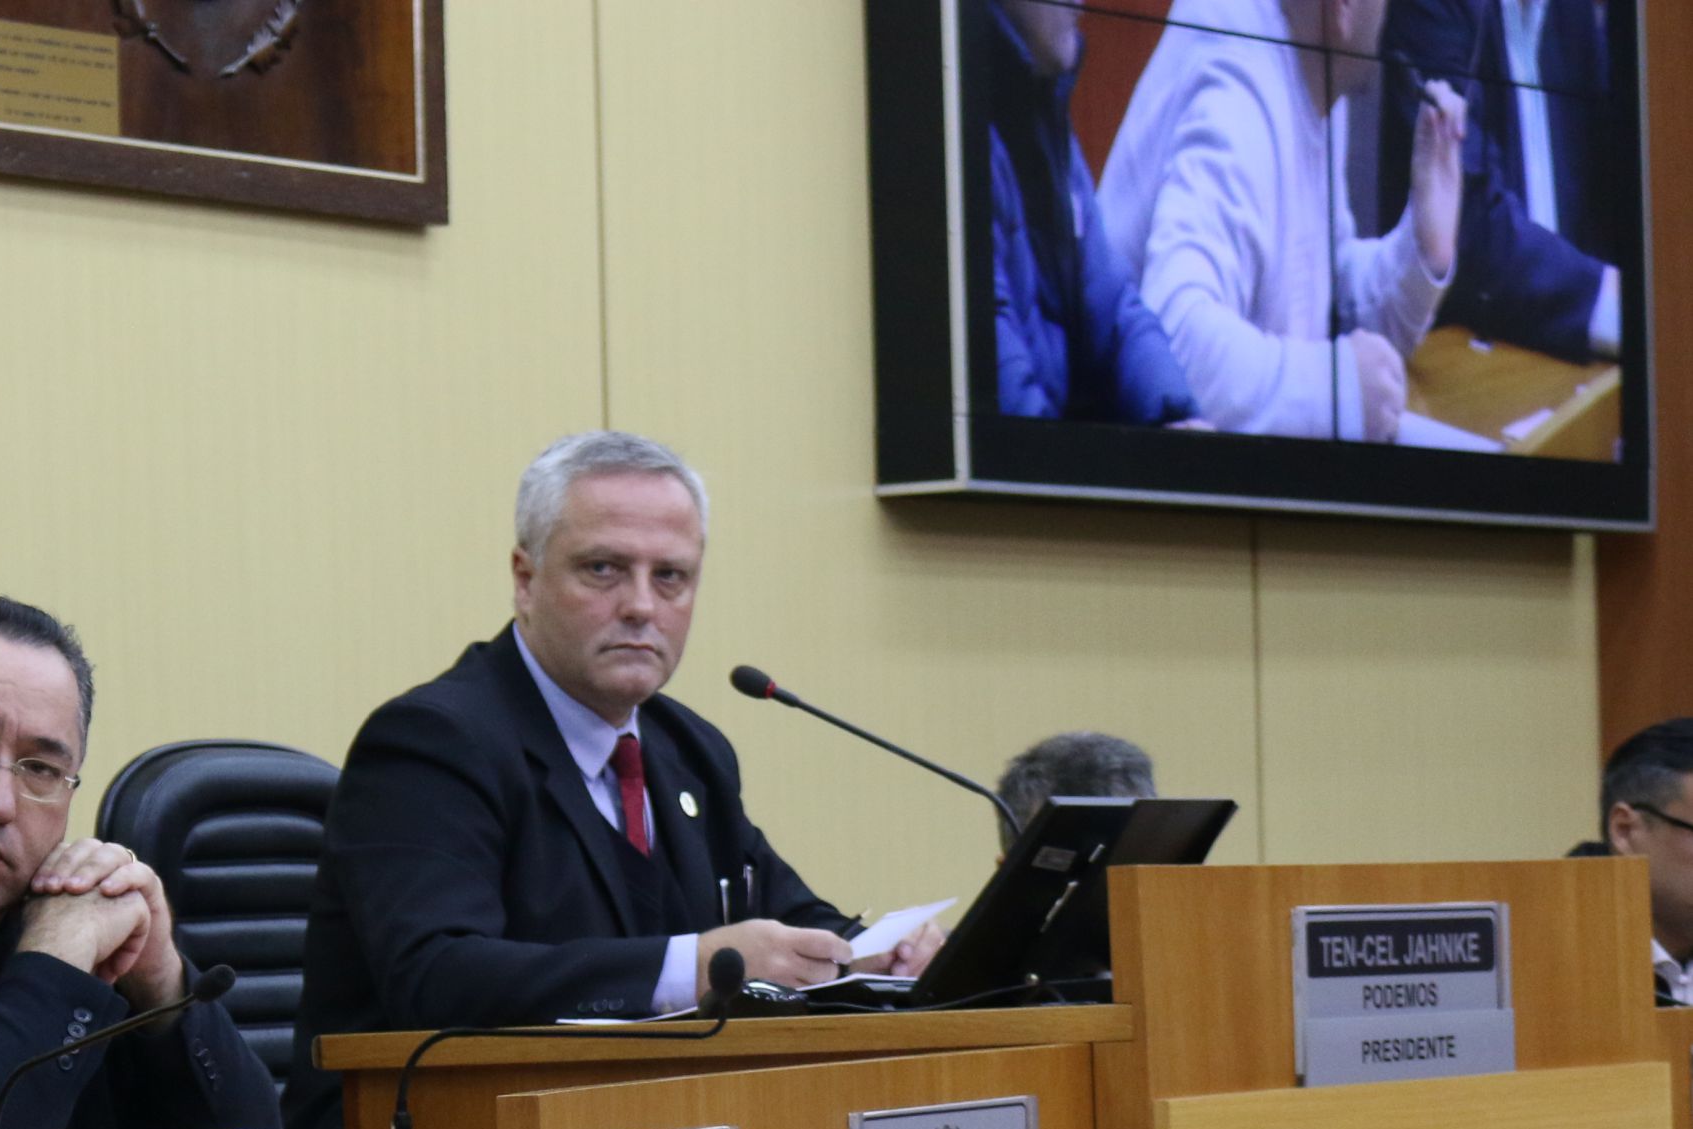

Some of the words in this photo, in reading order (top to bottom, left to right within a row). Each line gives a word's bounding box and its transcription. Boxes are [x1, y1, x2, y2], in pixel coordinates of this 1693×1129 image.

[1319, 934, 1400, 968] TEN-CEL
[1402, 932, 1481, 966] JAHNKE
[1362, 982, 1439, 1010] PODEMOS
[1361, 1035, 1457, 1064] PRESIDENTE
